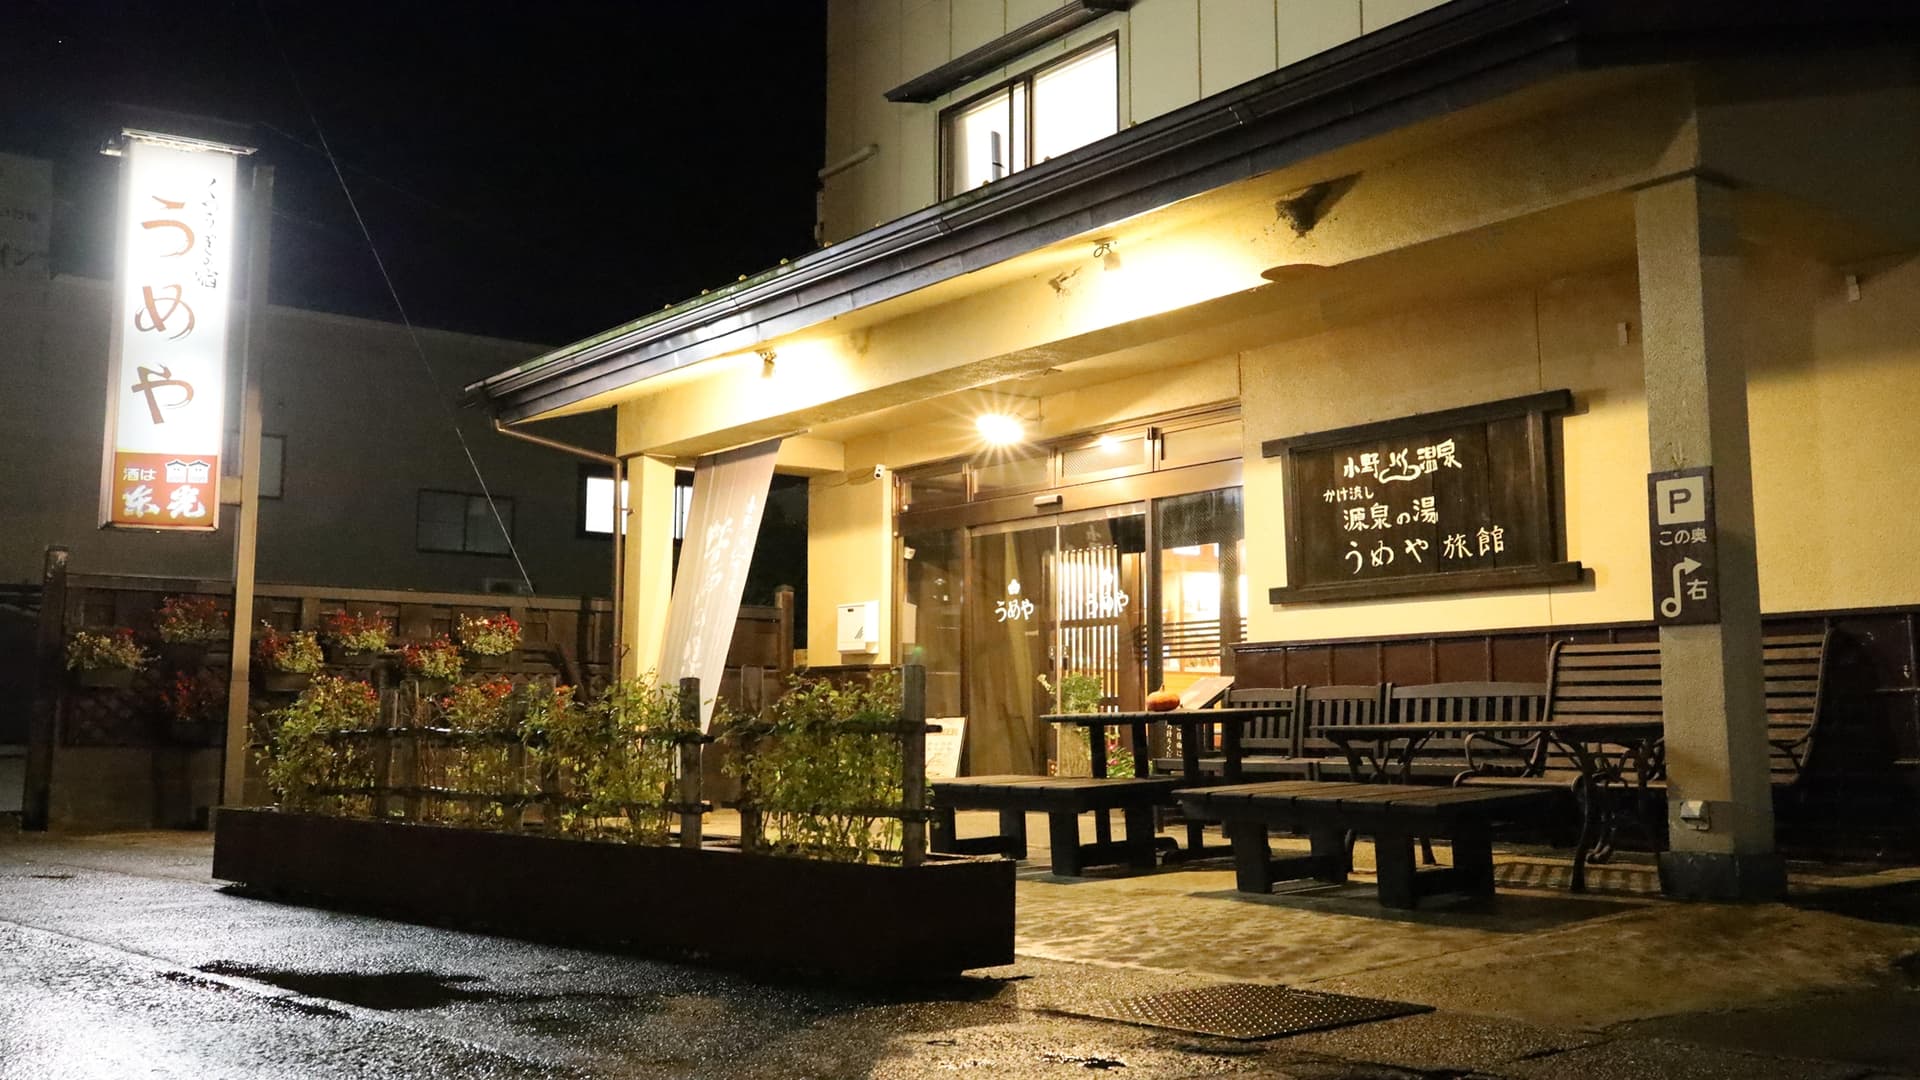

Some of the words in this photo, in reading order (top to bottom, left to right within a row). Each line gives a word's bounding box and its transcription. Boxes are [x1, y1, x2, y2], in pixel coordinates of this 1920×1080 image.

[131, 195, 195, 425] うめや
[1344, 438, 1462, 483] 小野川温泉
[123, 467, 157, 481] 酒は
[1323, 486, 1374, 503] かけ流し
[1669, 488, 1692, 514] P
[1343, 496, 1438, 532] 源泉の湯
[1659, 527, 1707, 546] この奥
[1686, 579, 1709, 600] 右
[994, 598, 1034, 623] うめや
